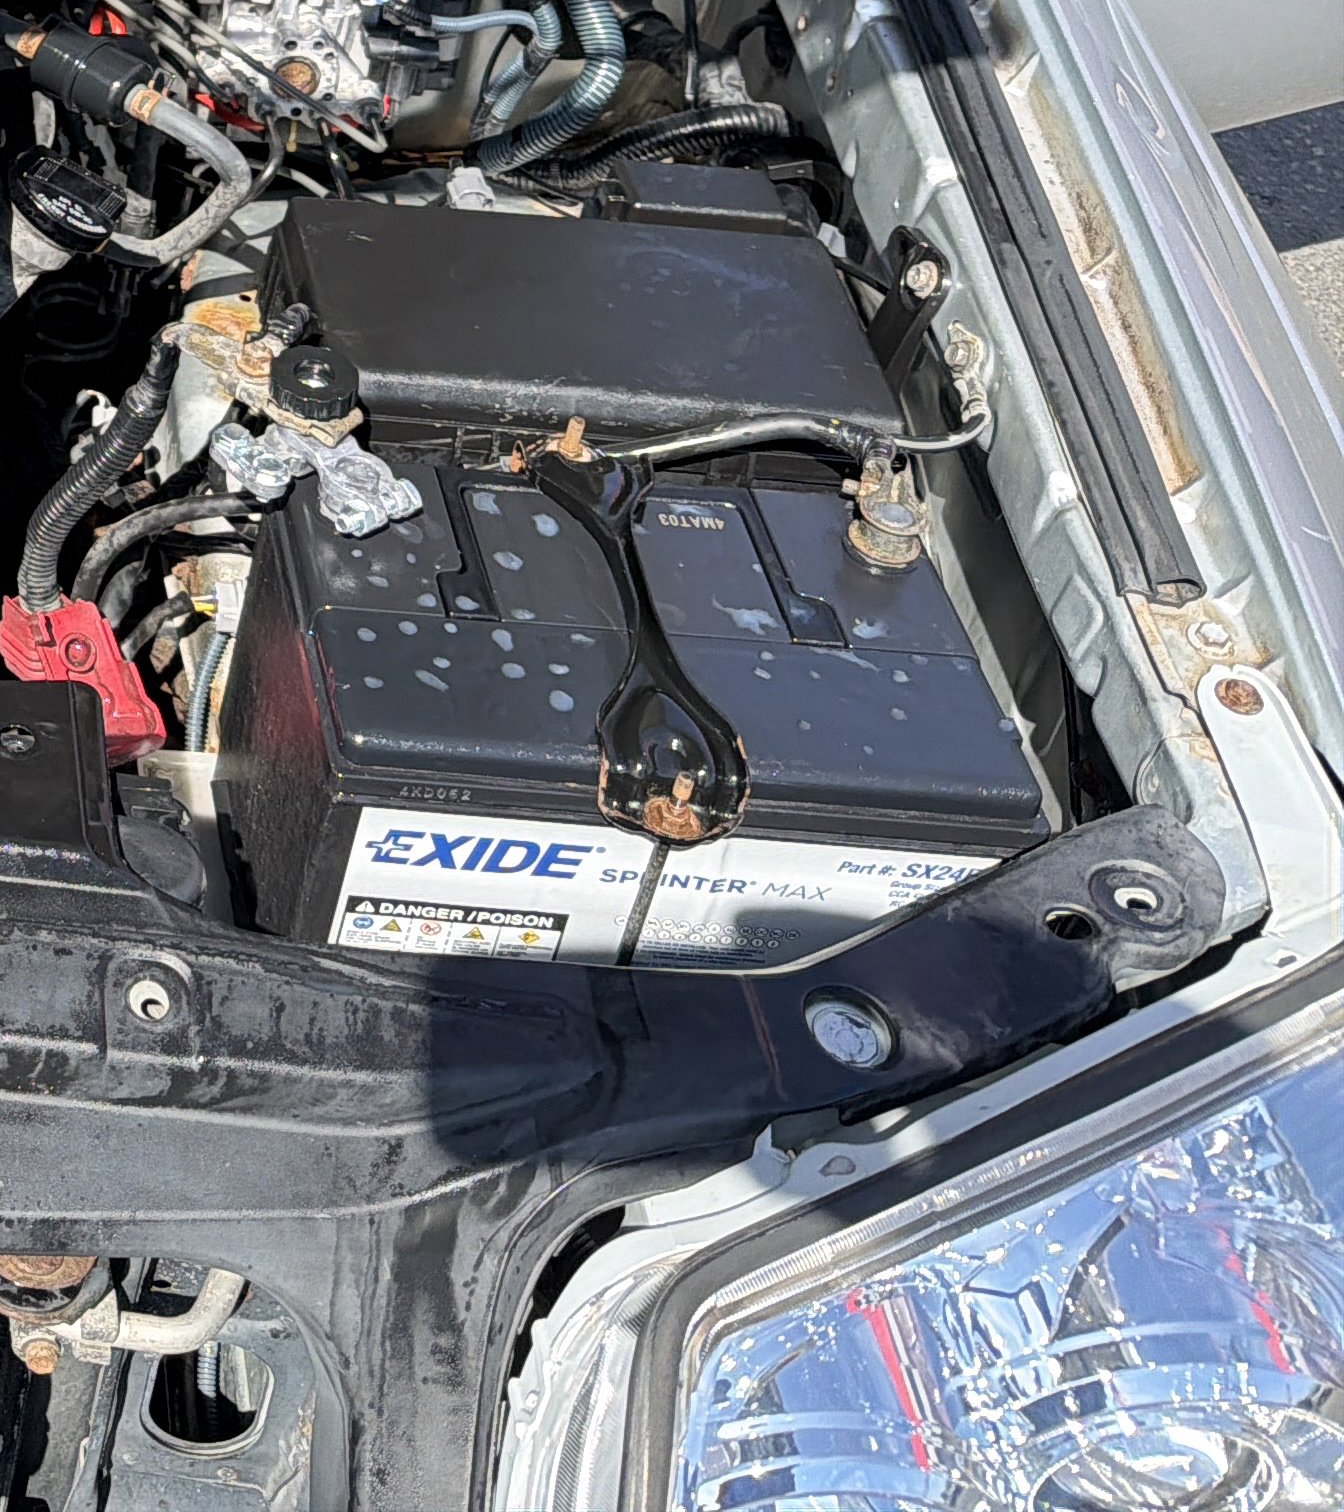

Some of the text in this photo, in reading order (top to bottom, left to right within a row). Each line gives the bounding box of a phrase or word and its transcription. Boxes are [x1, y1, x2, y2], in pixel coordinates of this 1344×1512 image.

[657, 512, 725, 531] 4MAT03
[365, 828, 595, 880] EXIDE
[599, 867, 748, 894] SPINTER
[761, 881, 833, 902] MAX
[836, 859, 876, 875] Part
[378, 901, 466, 921] DANGER
